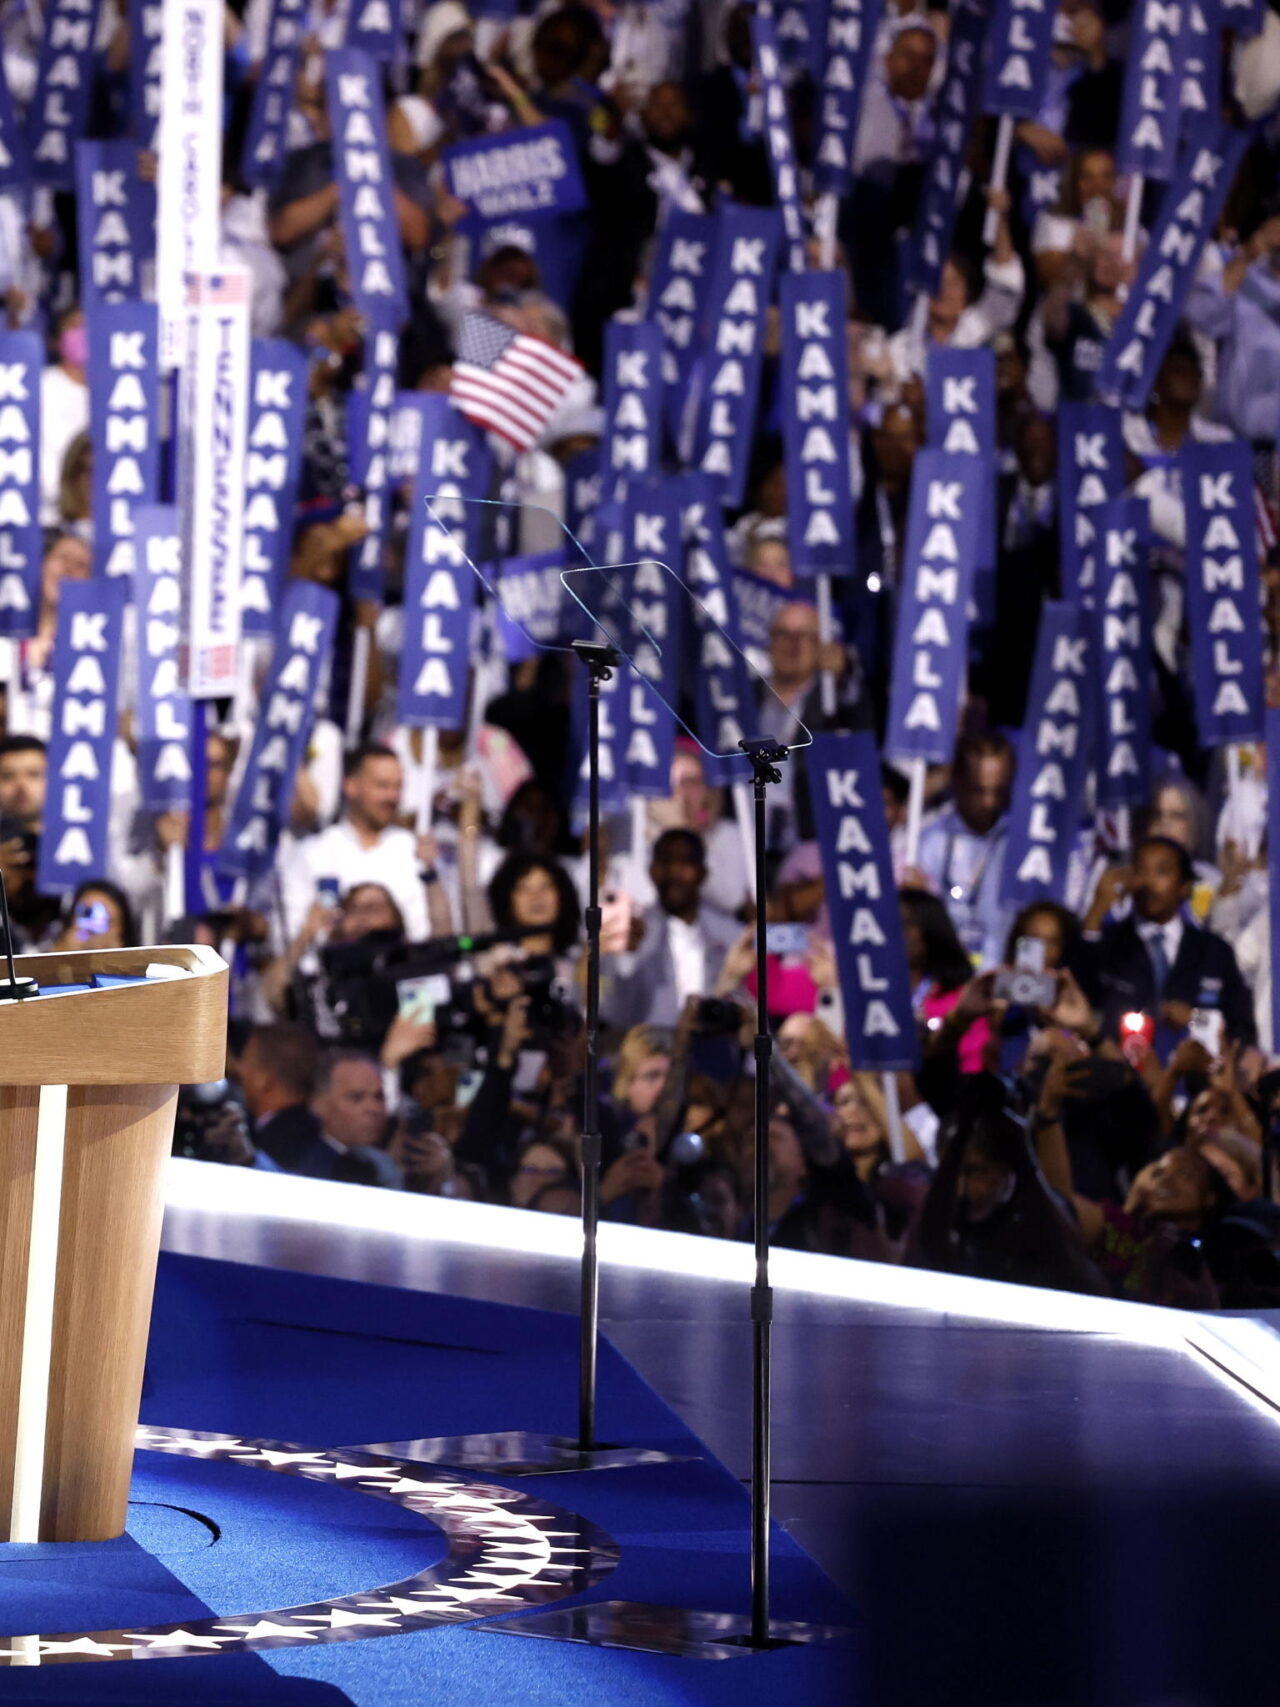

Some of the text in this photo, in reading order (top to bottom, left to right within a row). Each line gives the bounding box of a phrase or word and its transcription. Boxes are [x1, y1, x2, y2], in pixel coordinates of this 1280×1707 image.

[33, 0, 92, 164] MALA
[336, 73, 395, 297] KAMALA
[819, 0, 863, 169] MALA
[1131, 1, 1183, 152] MALA
[91, 170, 134, 304] KAM
[655, 236, 707, 386] KAM
[701, 236, 768, 477] KAMALA
[1116, 148, 1224, 379] KAMALA
[104, 331, 149, 578] KAMALA
[239, 369, 293, 613] KAMALA
[611, 350, 650, 503] KAM
[793, 301, 842, 548] KAMALA
[146, 536, 192, 782] KAMALA
[414, 438, 469, 697] KAMALA
[625, 512, 668, 768] KAMALA
[903, 480, 964, 732] KAMALA
[1104, 528, 1141, 778] KAMALA
[1199, 471, 1251, 716] KAMALA
[53, 611, 109, 867] KAMALA
[235, 610, 324, 854] KAMALA
[1017, 635, 1088, 885] KAMALA
[825, 769, 901, 1038] KAMALA
